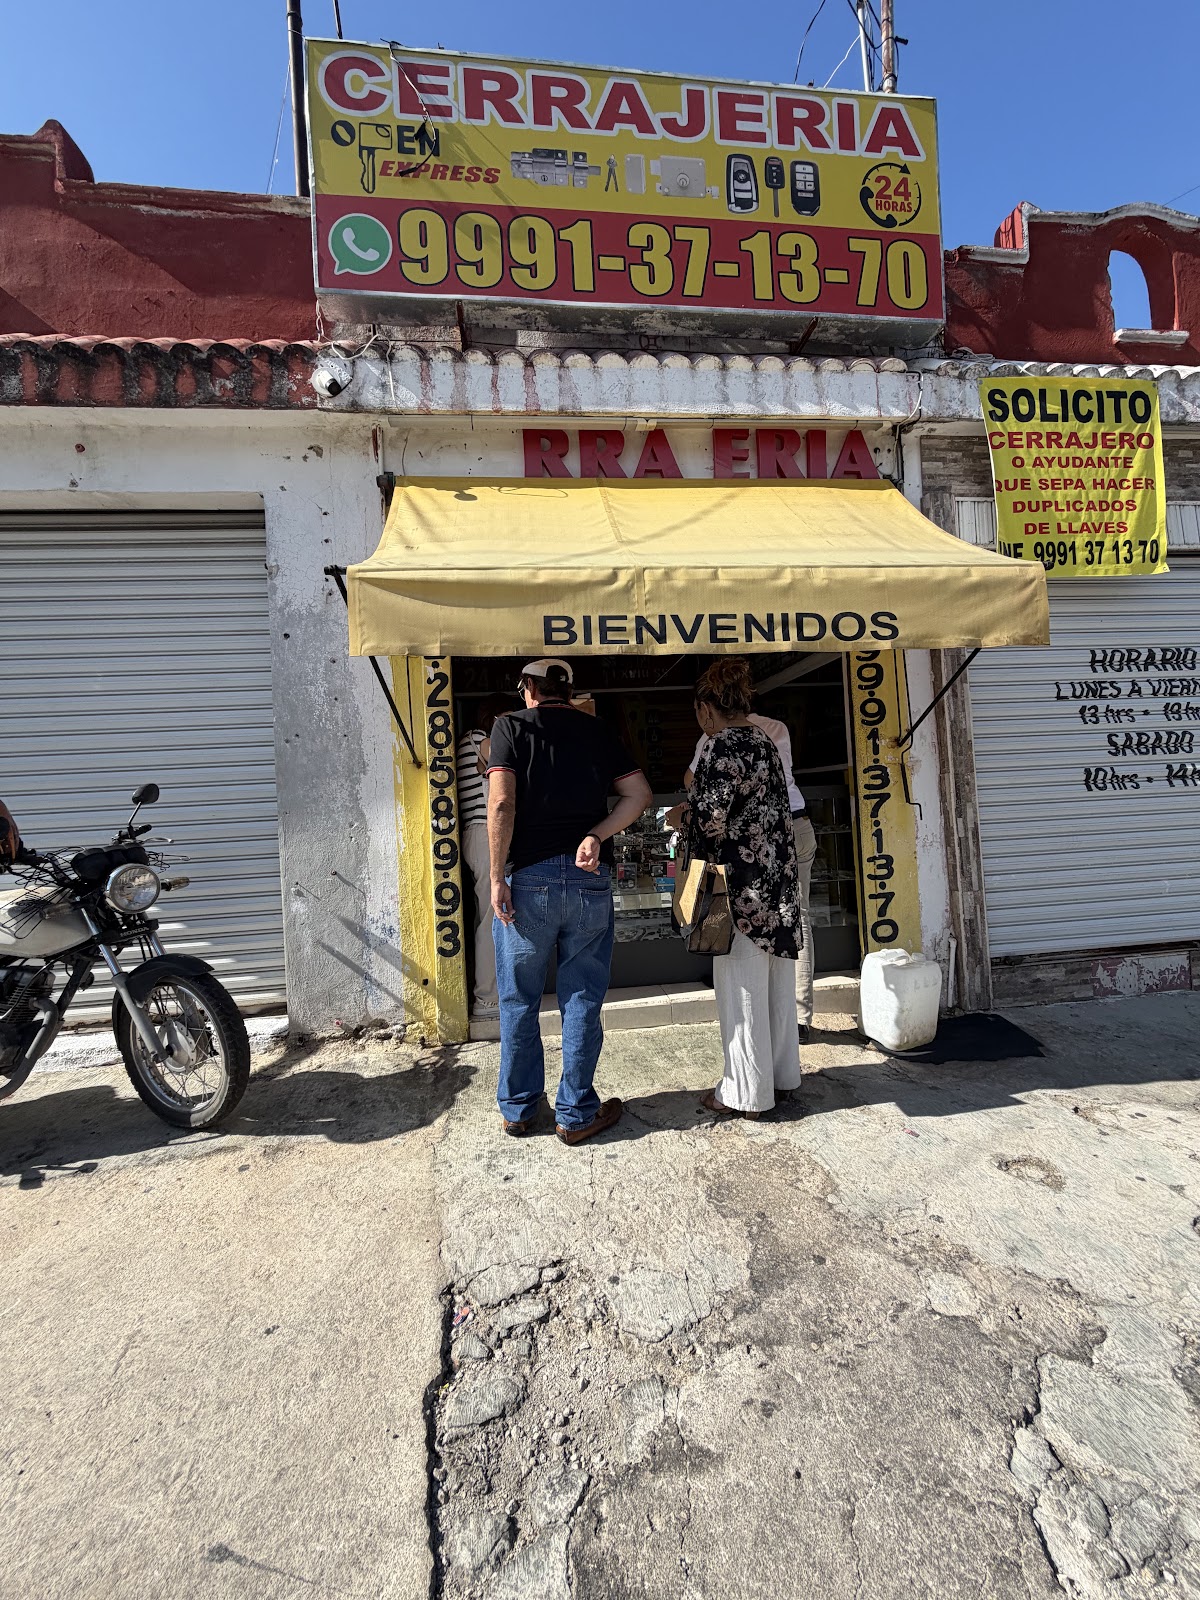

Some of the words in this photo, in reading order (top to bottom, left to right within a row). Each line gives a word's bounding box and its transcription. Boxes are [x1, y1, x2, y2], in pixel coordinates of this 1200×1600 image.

[319, 51, 925, 161] CERRAJERIA
[379, 160, 501, 184] EXPRESS
[874, 175, 911, 201] 24
[875, 200, 912, 213] HORAS
[397, 207, 929, 311] 9991-37-13-70
[987, 388, 1152, 424] SOLICITO
[988, 431, 1155, 450] CERRAJERO
[712, 429, 880, 479] ERIA
[1011, 456, 1025, 469] O
[1032, 456, 1134, 469] AYUDANTE
[995, 479, 1031, 493] QUE
[1038, 479, 1086, 491] SEPA
[1092, 478, 1155, 491] HACER
[1012, 500, 1137, 513] DUPLICADOS
[1024, 523, 1050, 535] DE
[1057, 522, 1128, 534] LLAVES
[1034, 541, 1077, 565] 9991
[1085, 541, 1105, 565] 37
[1112, 540, 1133, 564] 13
[1139, 539, 1159, 563] 70
[543, 611, 899, 646] BIENVENIDOS
[1089, 647, 1197, 673] HORARIO
[1055, 680, 1122, 700] LUNES
[1127, 679, 1143, 698] A
[1106, 730, 1195, 756] SABADO
[119, 926, 150, 938] HONDA
